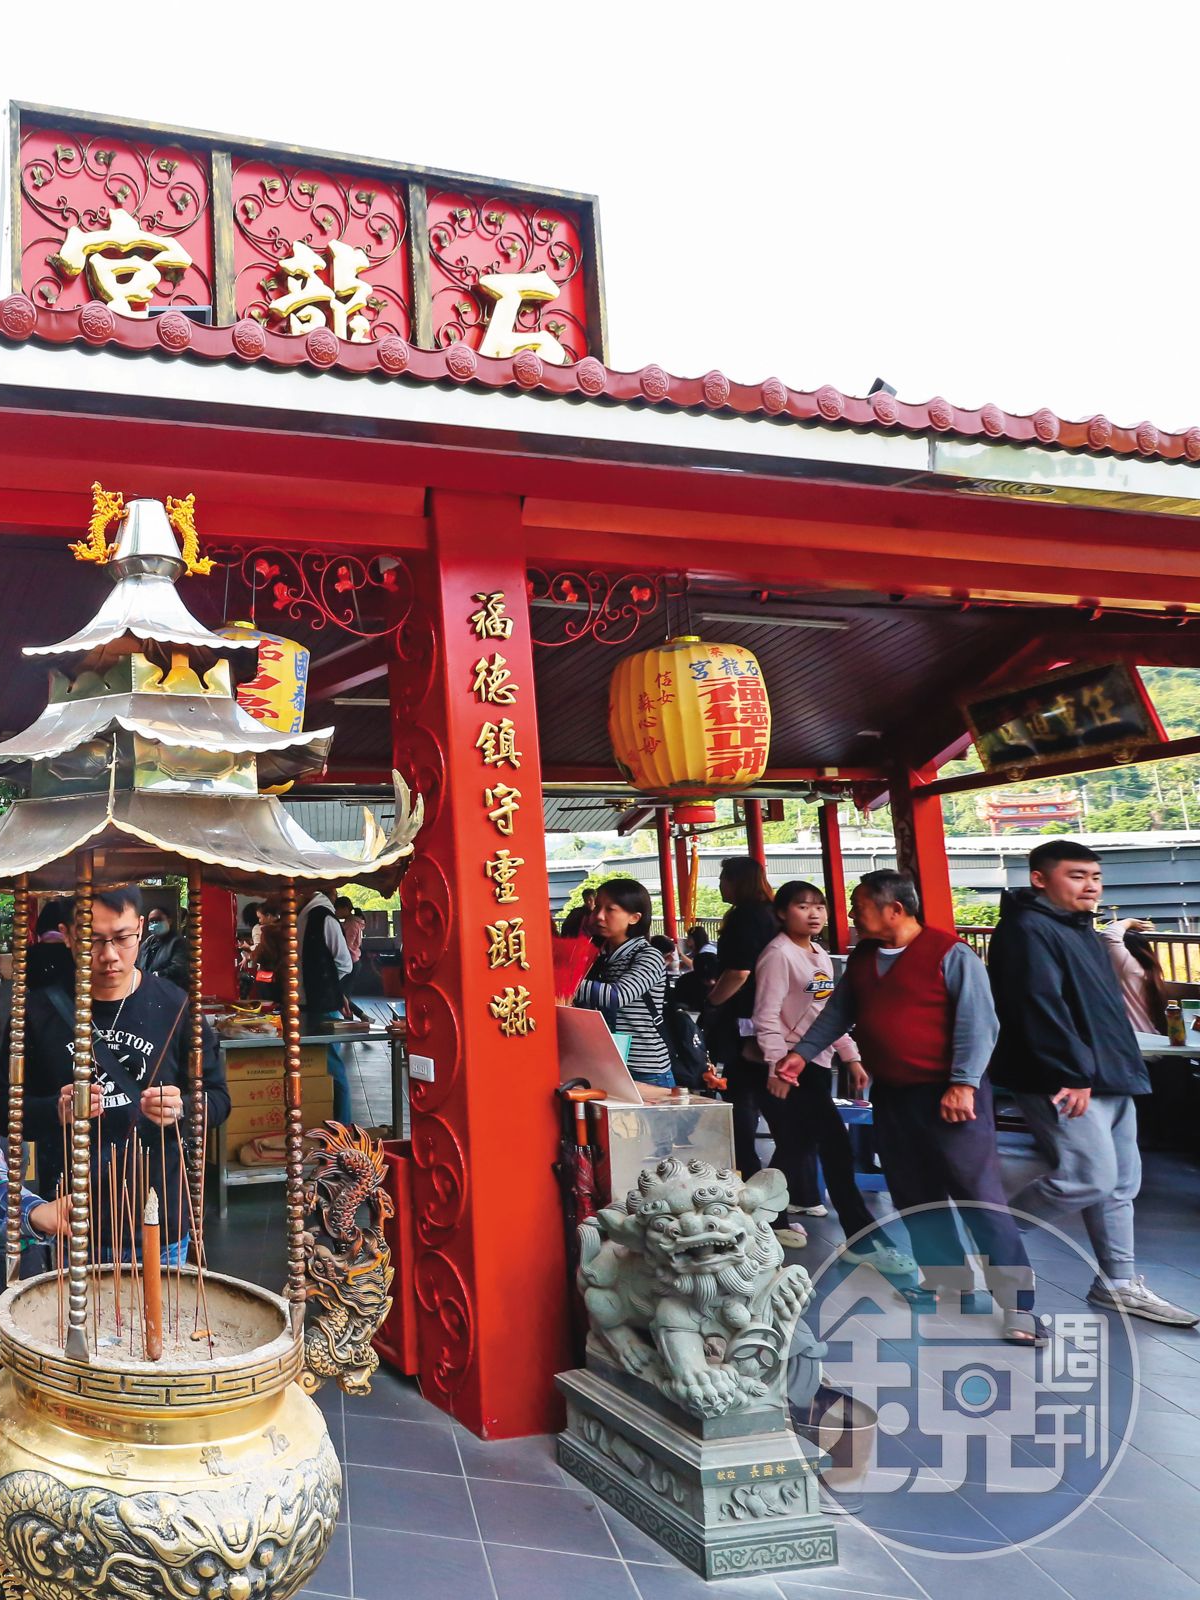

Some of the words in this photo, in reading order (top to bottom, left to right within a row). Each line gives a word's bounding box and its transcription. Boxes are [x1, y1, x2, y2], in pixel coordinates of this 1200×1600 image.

[689, 657, 760, 680] 石龍宮
[698, 675, 769, 778] 福德正神
